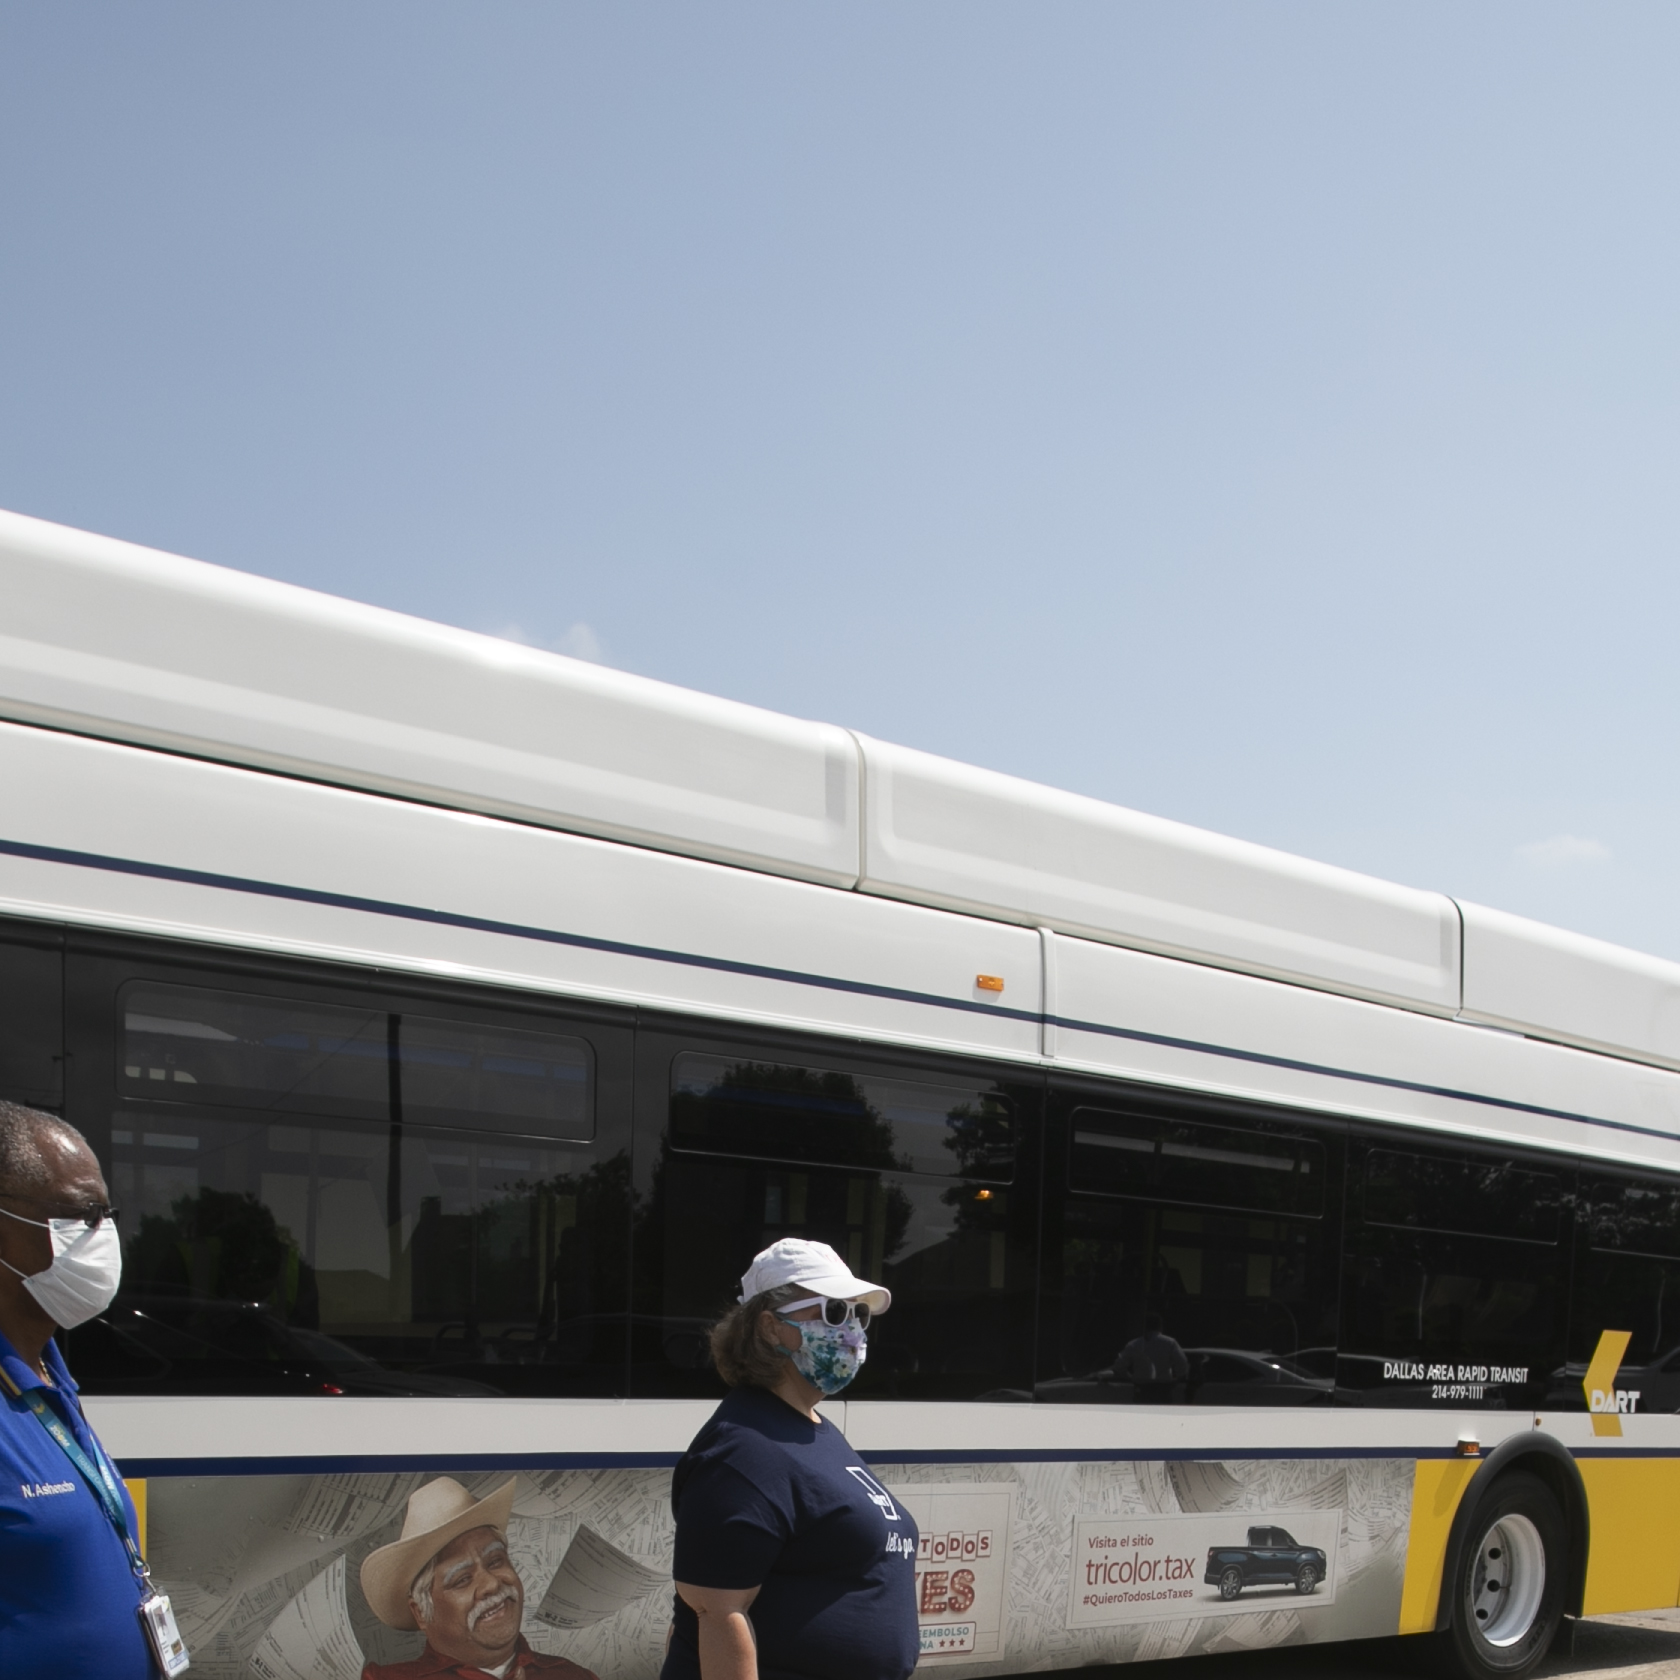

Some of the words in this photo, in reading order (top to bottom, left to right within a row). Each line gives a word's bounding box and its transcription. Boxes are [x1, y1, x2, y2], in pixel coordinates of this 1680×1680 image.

[1383, 1362, 1425, 1380] DALLAS
[1426, 1364, 1455, 1381] AREA
[1457, 1365, 1488, 1382] RAPID
[1490, 1366, 1529, 1383] TRANSIT
[1432, 1385, 1484, 1400] 214-979-1111
[1591, 1389, 1641, 1413] DART
[885, 1531, 903, 1552] let's
[920, 1535, 989, 1556] TODOS
[1088, 1536, 1117, 1549] Visita
[1120, 1535, 1130, 1547] el
[1132, 1533, 1154, 1547] sitio
[1085, 1551, 1196, 1585] tricolor.tax
[1083, 1589, 1193, 1607] #QuieroTodosLosTaxes
